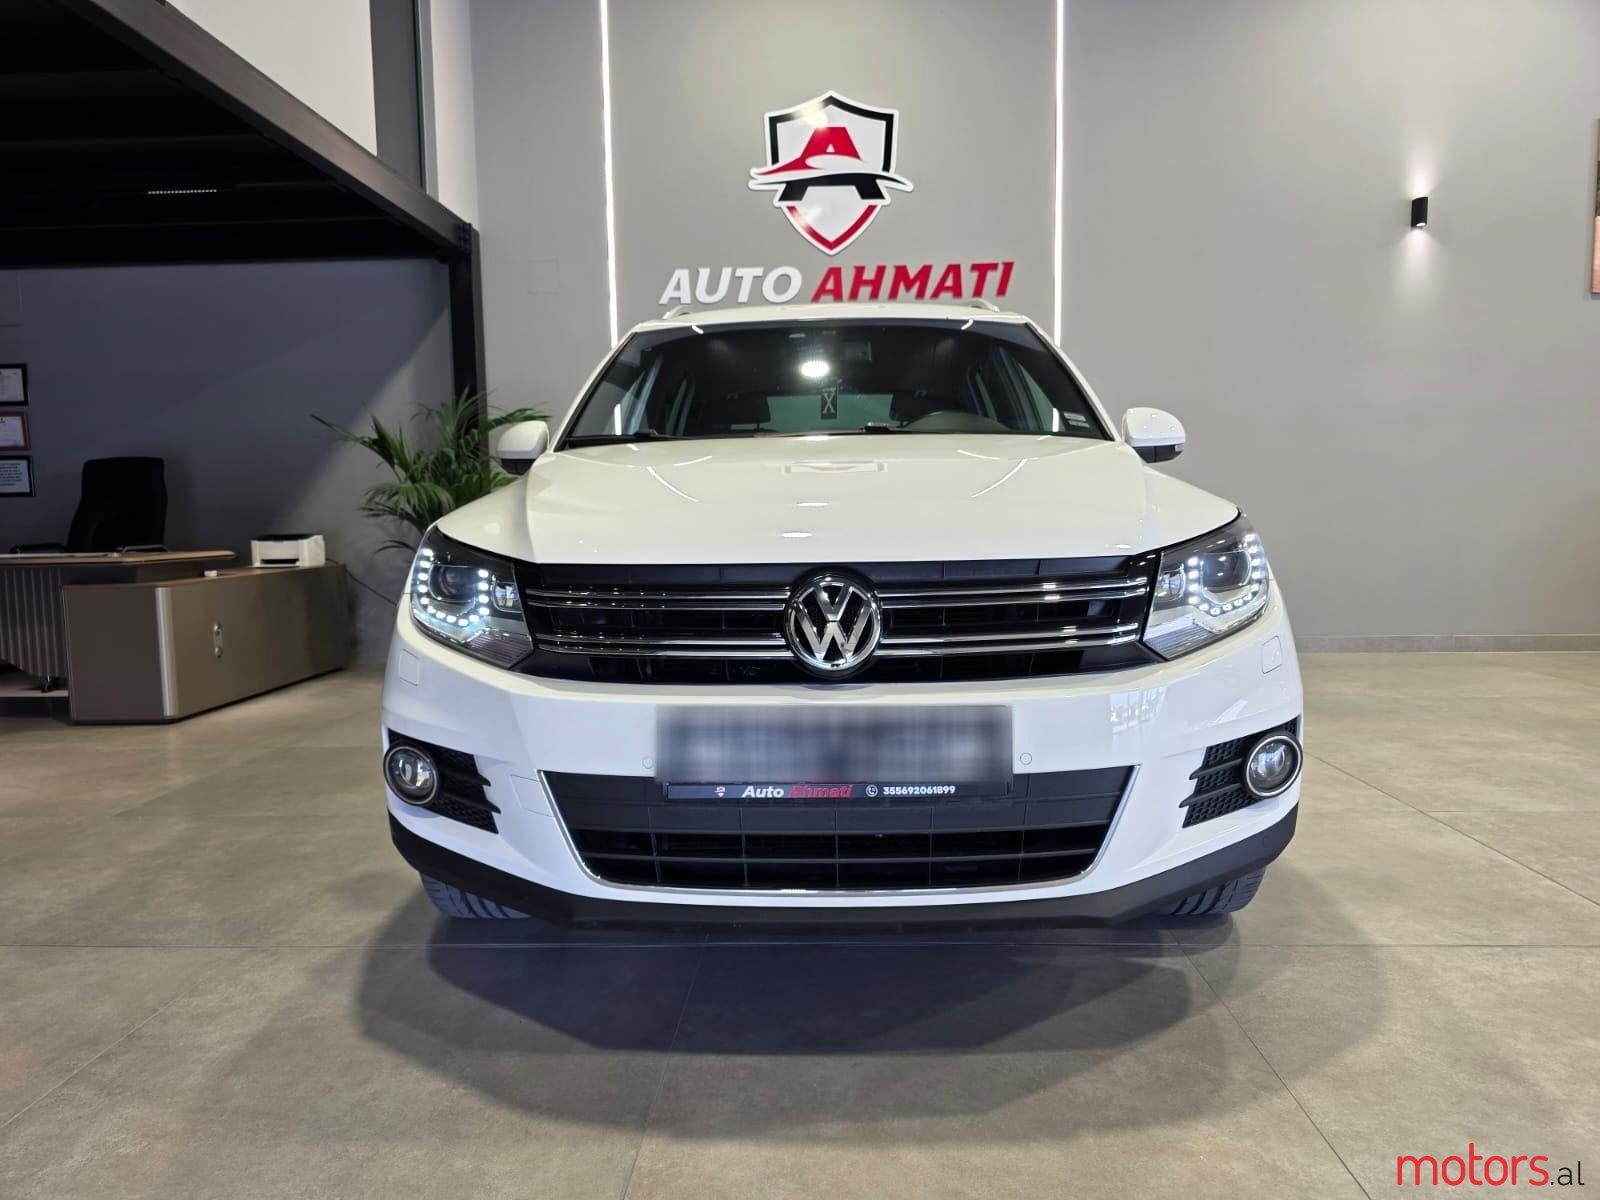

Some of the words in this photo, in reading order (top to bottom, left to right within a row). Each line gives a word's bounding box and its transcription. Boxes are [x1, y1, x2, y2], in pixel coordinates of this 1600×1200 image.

[658, 266, 803, 304] AUTO
[811, 262, 1014, 303] AHMATI
[742, 785, 784, 798] Auto
[788, 784, 853, 798] Ahmati
[882, 785, 956, 796] 355692061899
